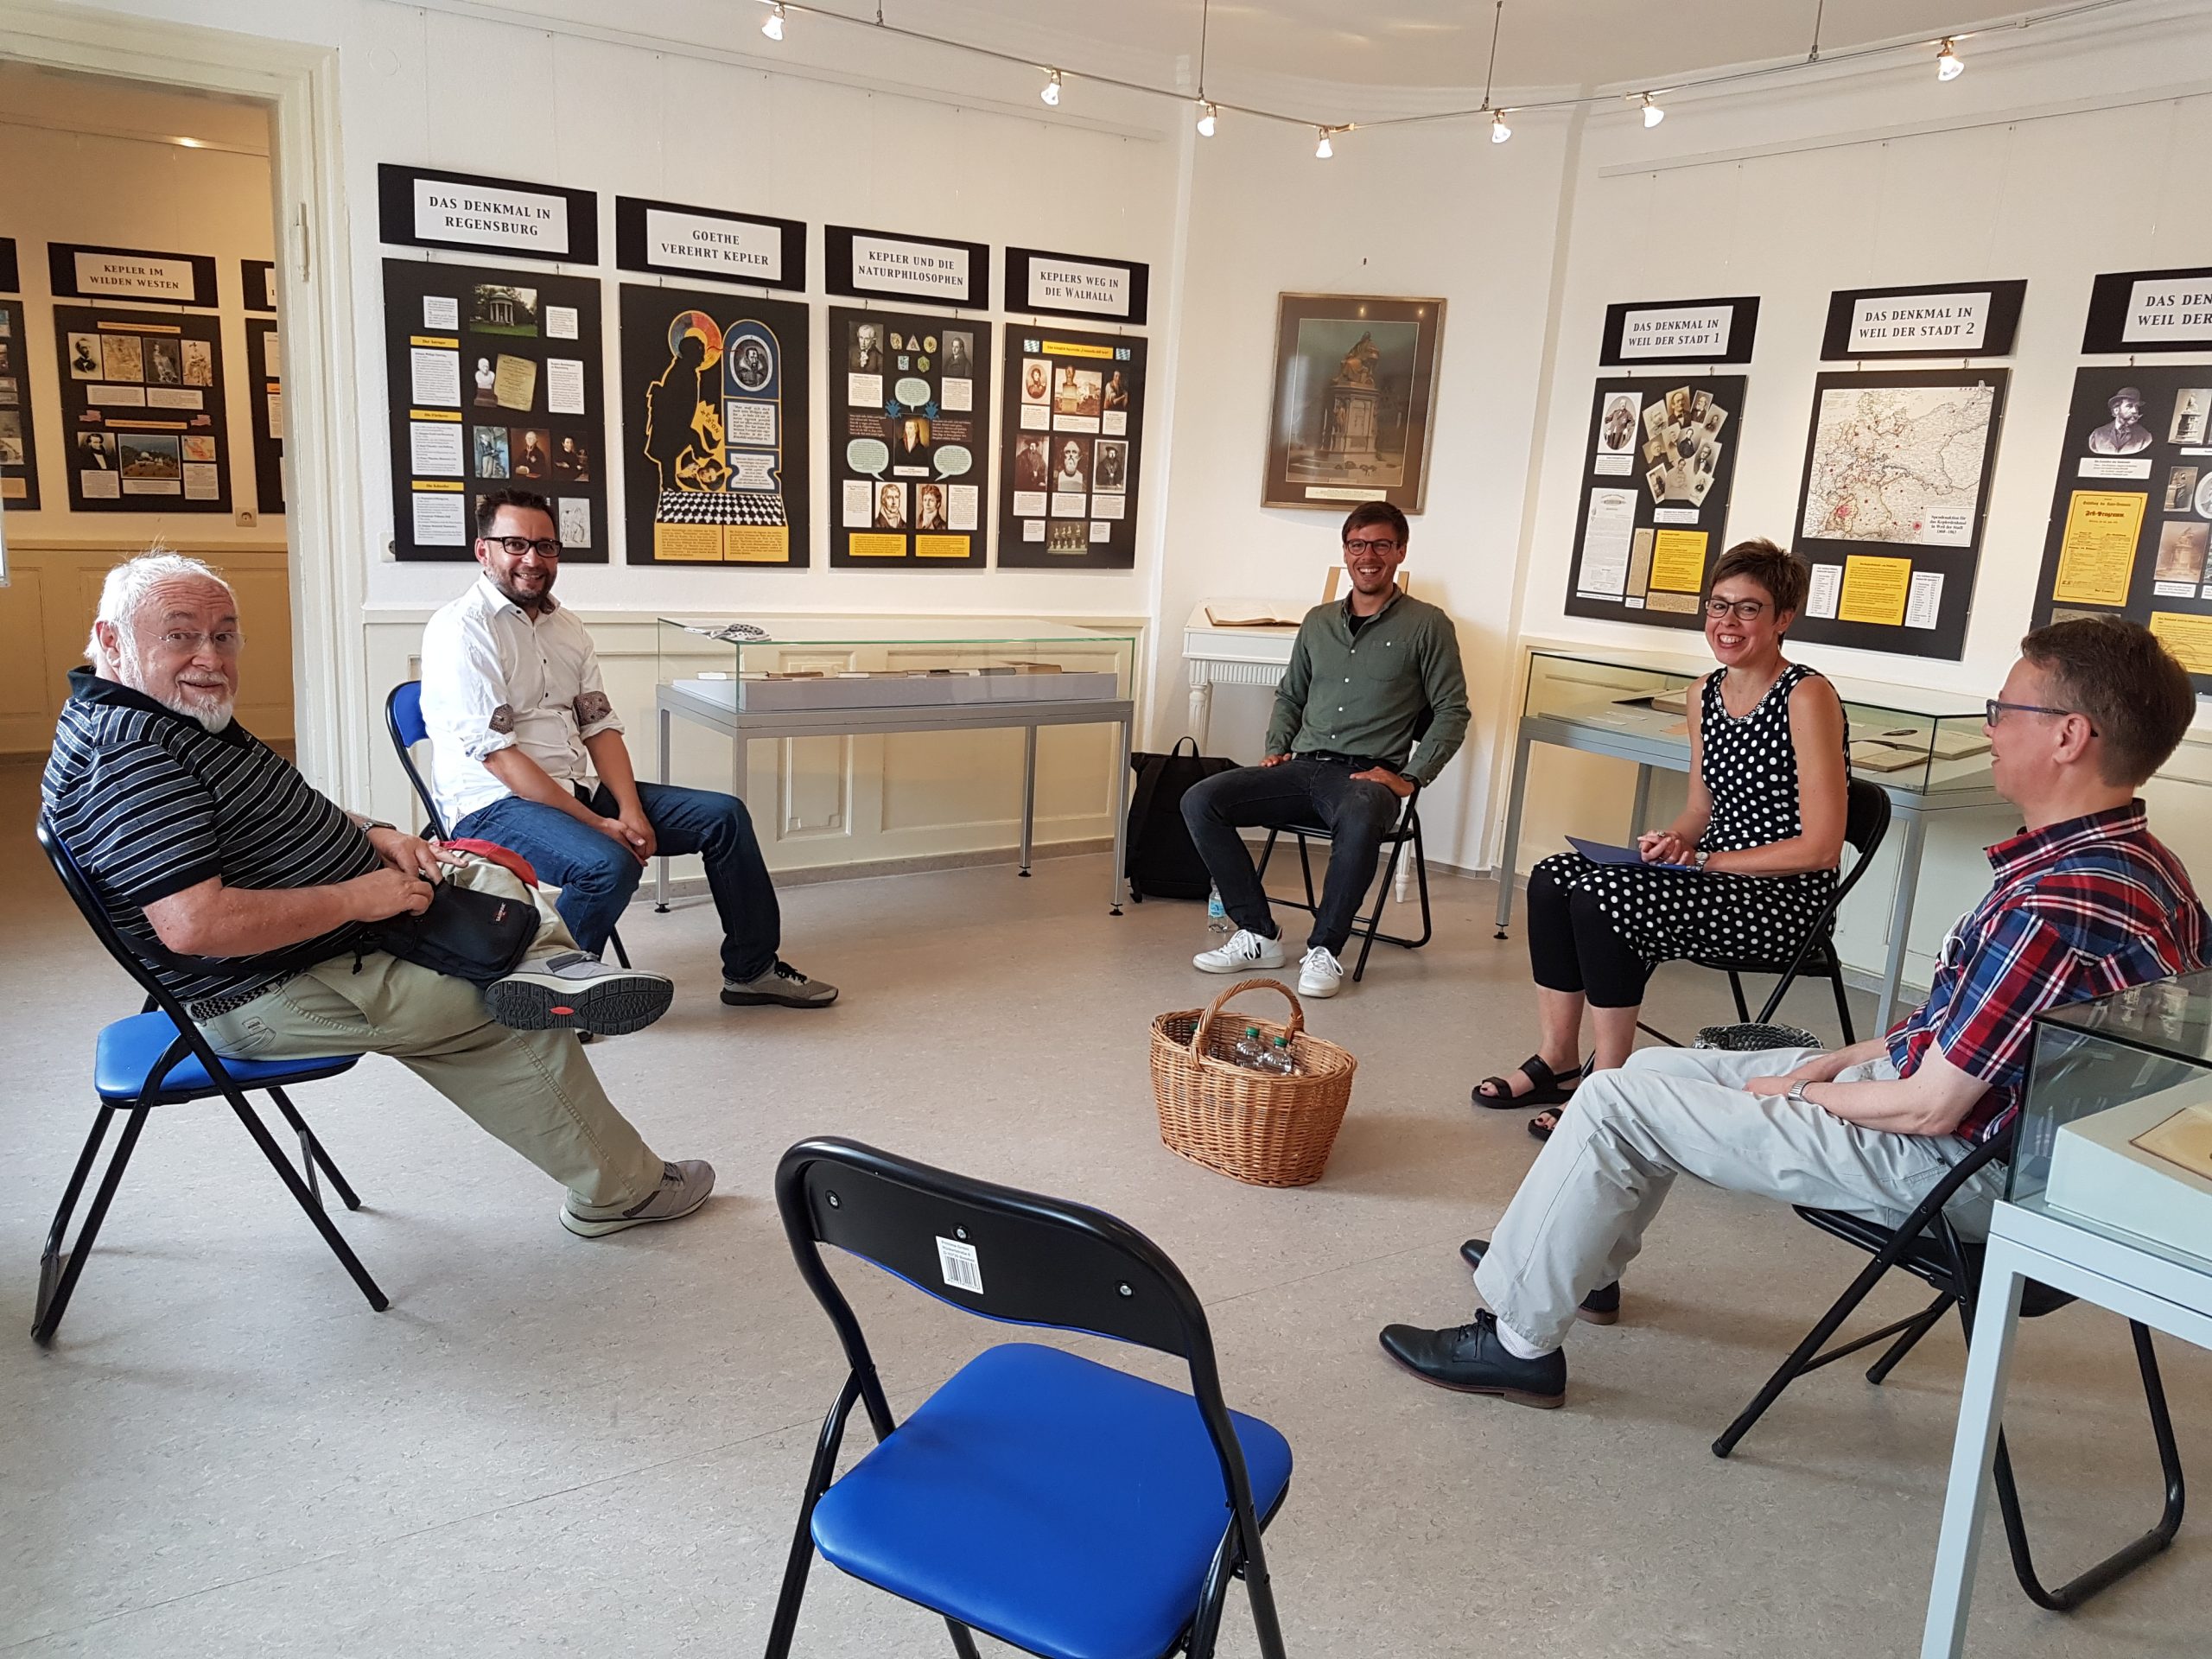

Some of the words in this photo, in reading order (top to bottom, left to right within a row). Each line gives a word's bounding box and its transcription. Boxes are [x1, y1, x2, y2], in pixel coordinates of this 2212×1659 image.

[429, 196, 457, 209] DAS
[464, 200, 531, 218] DENKMAL
[537, 208, 550, 219] IN
[445, 216, 538, 236] REGENSBURG
[692, 230, 740, 245] GOETHE
[661, 243, 718, 258] VEREHRT
[724, 251, 769, 265] KEPLER
[868, 251, 909, 264] KEPLER
[913, 257, 934, 267] UND
[938, 259, 955, 270] DIE
[104, 264, 145, 275] KEPLER
[858, 265, 963, 286] NATURPHILOSOPHEN
[90, 276, 132, 286] WILDEN
[137, 279, 179, 289] WESTEN
[1040, 271, 1082, 284] KEPLERS
[1086, 276, 1106, 287] WEG
[1109, 279, 1119, 288] IN
[1046, 286, 1061, 296] DIE
[1065, 287, 1114, 302] WALHALLA
[2145, 295, 2176, 307] DAS
[1865, 311, 1887, 321] DAS
[1892, 308, 1952, 321] DENKMAL
[1957, 307, 1973, 317] IN
[2138, 314, 2175, 326] WEIL
[2182, 313, 2212, 325] DER
[1633, 322, 1651, 332] DAS
[1655, 320, 1703, 331] DENKMAL
[1707, 319, 1719, 328] IN
[1859, 327, 1887, 338] WEIL
[1892, 327, 1916, 337] DER
[1920, 325, 1961, 336] STADT
[1966, 321, 1974, 334] 2
[1629, 337, 1651, 346] WEIL
[1655, 336, 1675, 345] DER
[1678, 334, 1710, 345] STADT
[1713, 333, 1719, 343] 1
